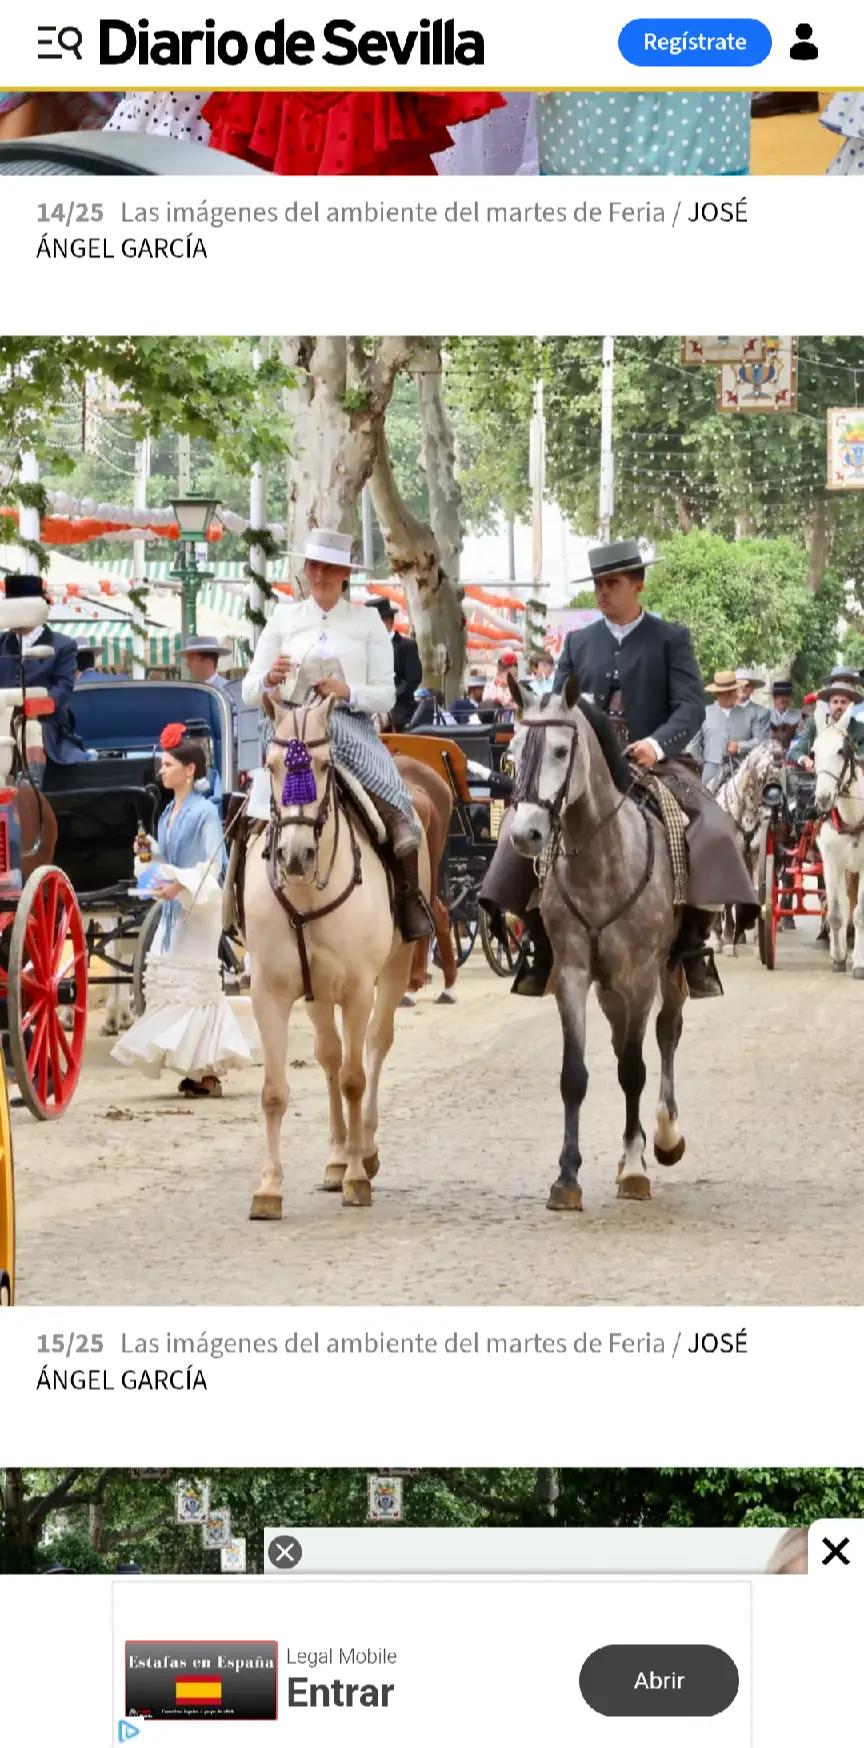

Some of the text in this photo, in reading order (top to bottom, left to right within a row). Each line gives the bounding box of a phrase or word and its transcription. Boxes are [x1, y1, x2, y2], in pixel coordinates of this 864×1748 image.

[99, 18, 485, 67] Diario de Sevilla
[644, 31, 747, 56] Regístrate
[37, 195, 748, 229] 14/25 Las imágenes del ambiente del martes de Feria / JOSÉ
[35, 233, 208, 259] ÁNGEL GARCÍA
[37, 1326, 748, 1360] 15/25 Las imágenes del ambiente del martes de Feria / JOSÉ
[35, 1364, 208, 1390] ÁNGEL GARCÍA
[128, 1655, 275, 1673] Estafas en España
[286, 1647, 398, 1669] Legal Mobile
[287, 1676, 395, 1708] Entrar
[633, 1670, 686, 1690] Abrir
